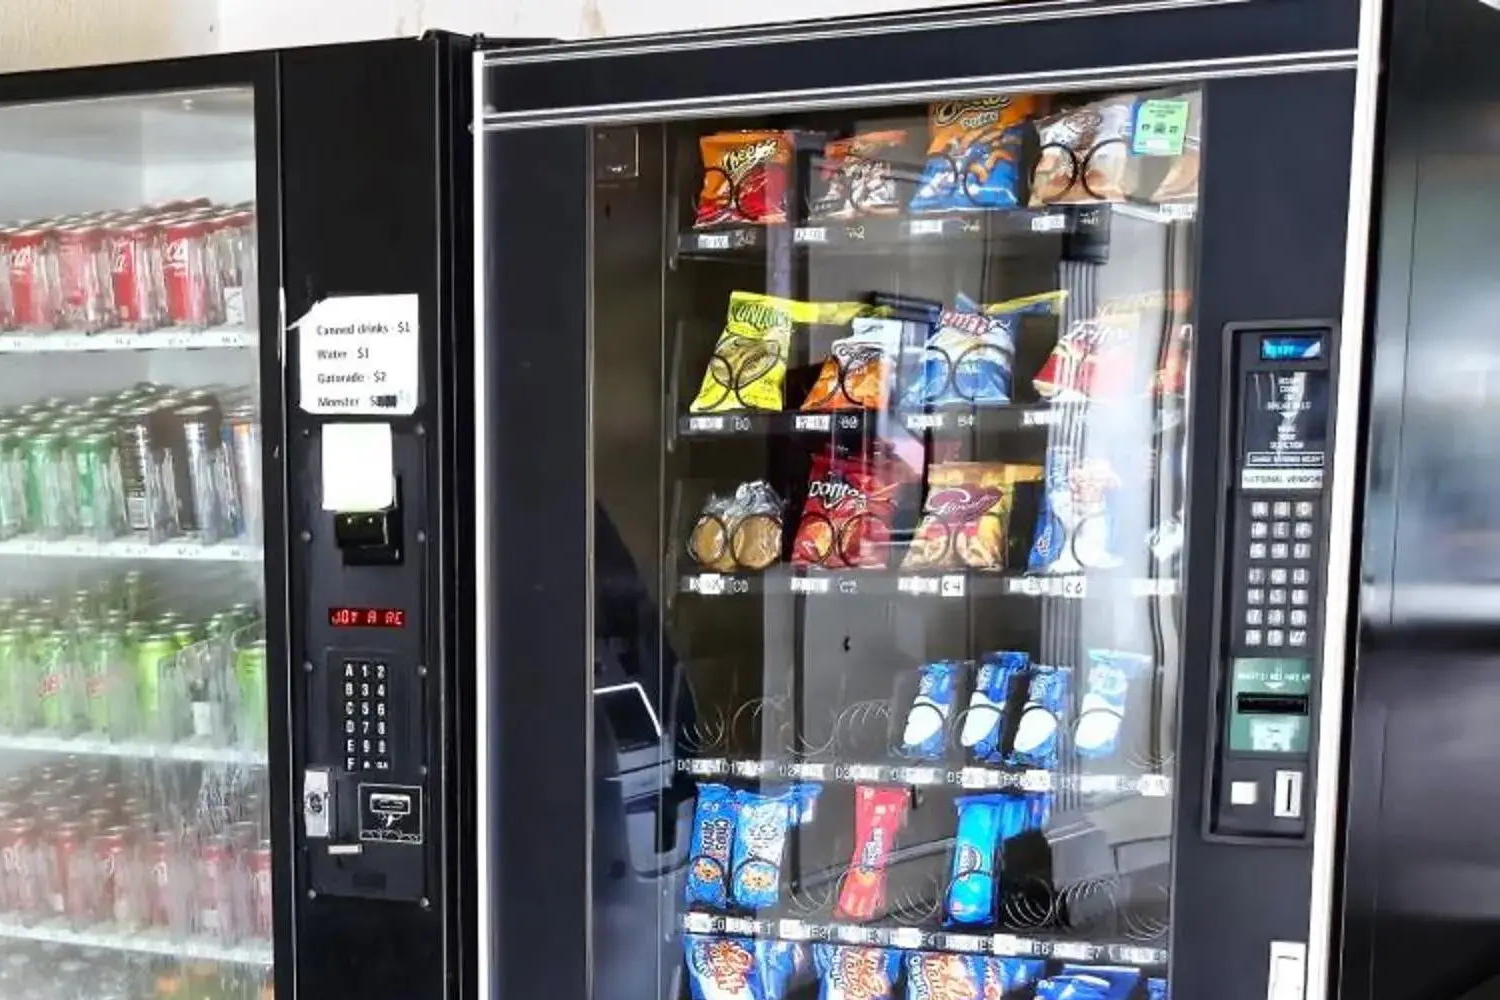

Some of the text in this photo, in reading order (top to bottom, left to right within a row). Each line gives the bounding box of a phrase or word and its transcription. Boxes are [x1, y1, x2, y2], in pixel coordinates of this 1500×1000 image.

[316, 321, 411, 336] Canned drinks $1
[317, 347, 369, 360] Water $1
[317, 371, 387, 384] Gatorade $2
[317, 396, 359, 407] Monster
[345, 664, 354, 677] A
[377, 665, 386, 678] 2
[345, 683, 386, 697] B 3 4
[345, 702, 386, 716] C 5 6
[345, 720, 386, 735] D 7 8
[347, 739, 355, 752] E
[347, 758, 355, 770] F
